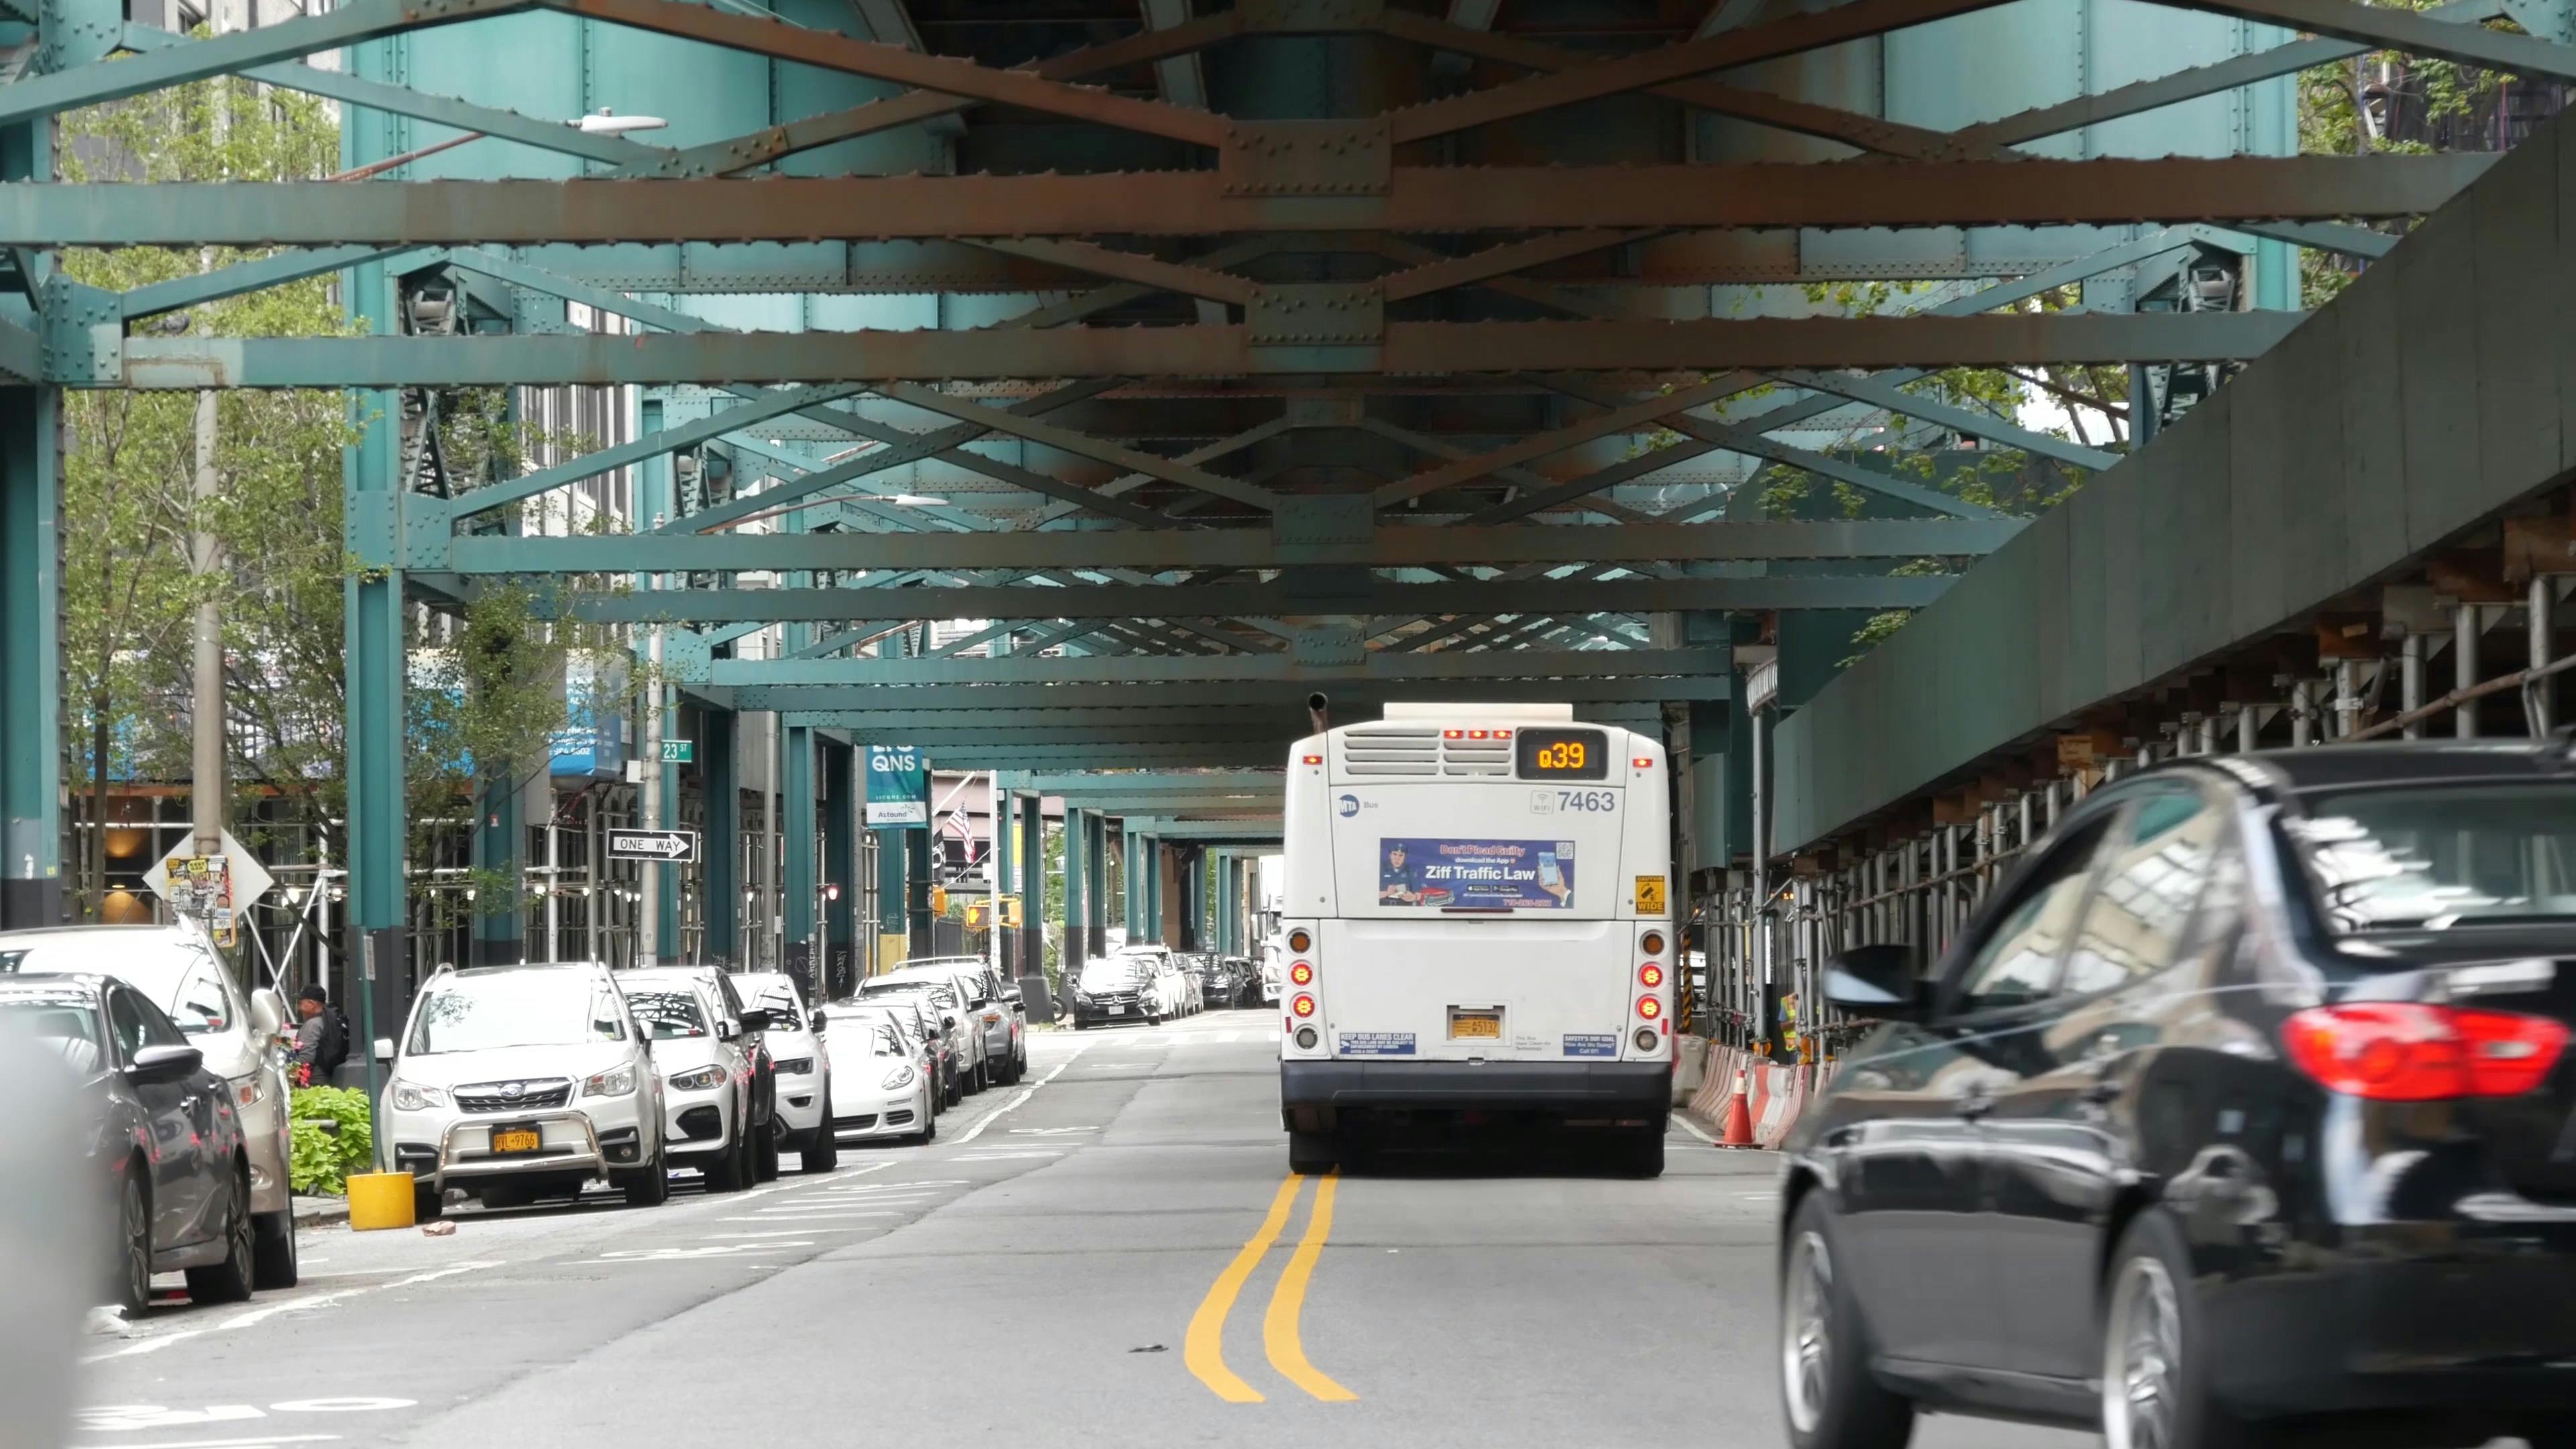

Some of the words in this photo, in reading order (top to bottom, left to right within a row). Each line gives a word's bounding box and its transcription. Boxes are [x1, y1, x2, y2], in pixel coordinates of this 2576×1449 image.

[663, 743, 678, 759] 23
[680, 743, 688, 752] ST
[1539, 743, 1585, 768] Q39
[872, 755, 916, 772] QNS
[1557, 792, 1615, 812] 7463
[620, 839, 644, 850] ONE
[655, 840, 681, 851] WAY
[1426, 865, 1452, 879] Ziff
[1453, 866, 1502, 880] Traffic
[1503, 867, 1536, 880] Law
[1638, 902, 1664, 910] WIDE
[515, 1134, 535, 1146] 9766
